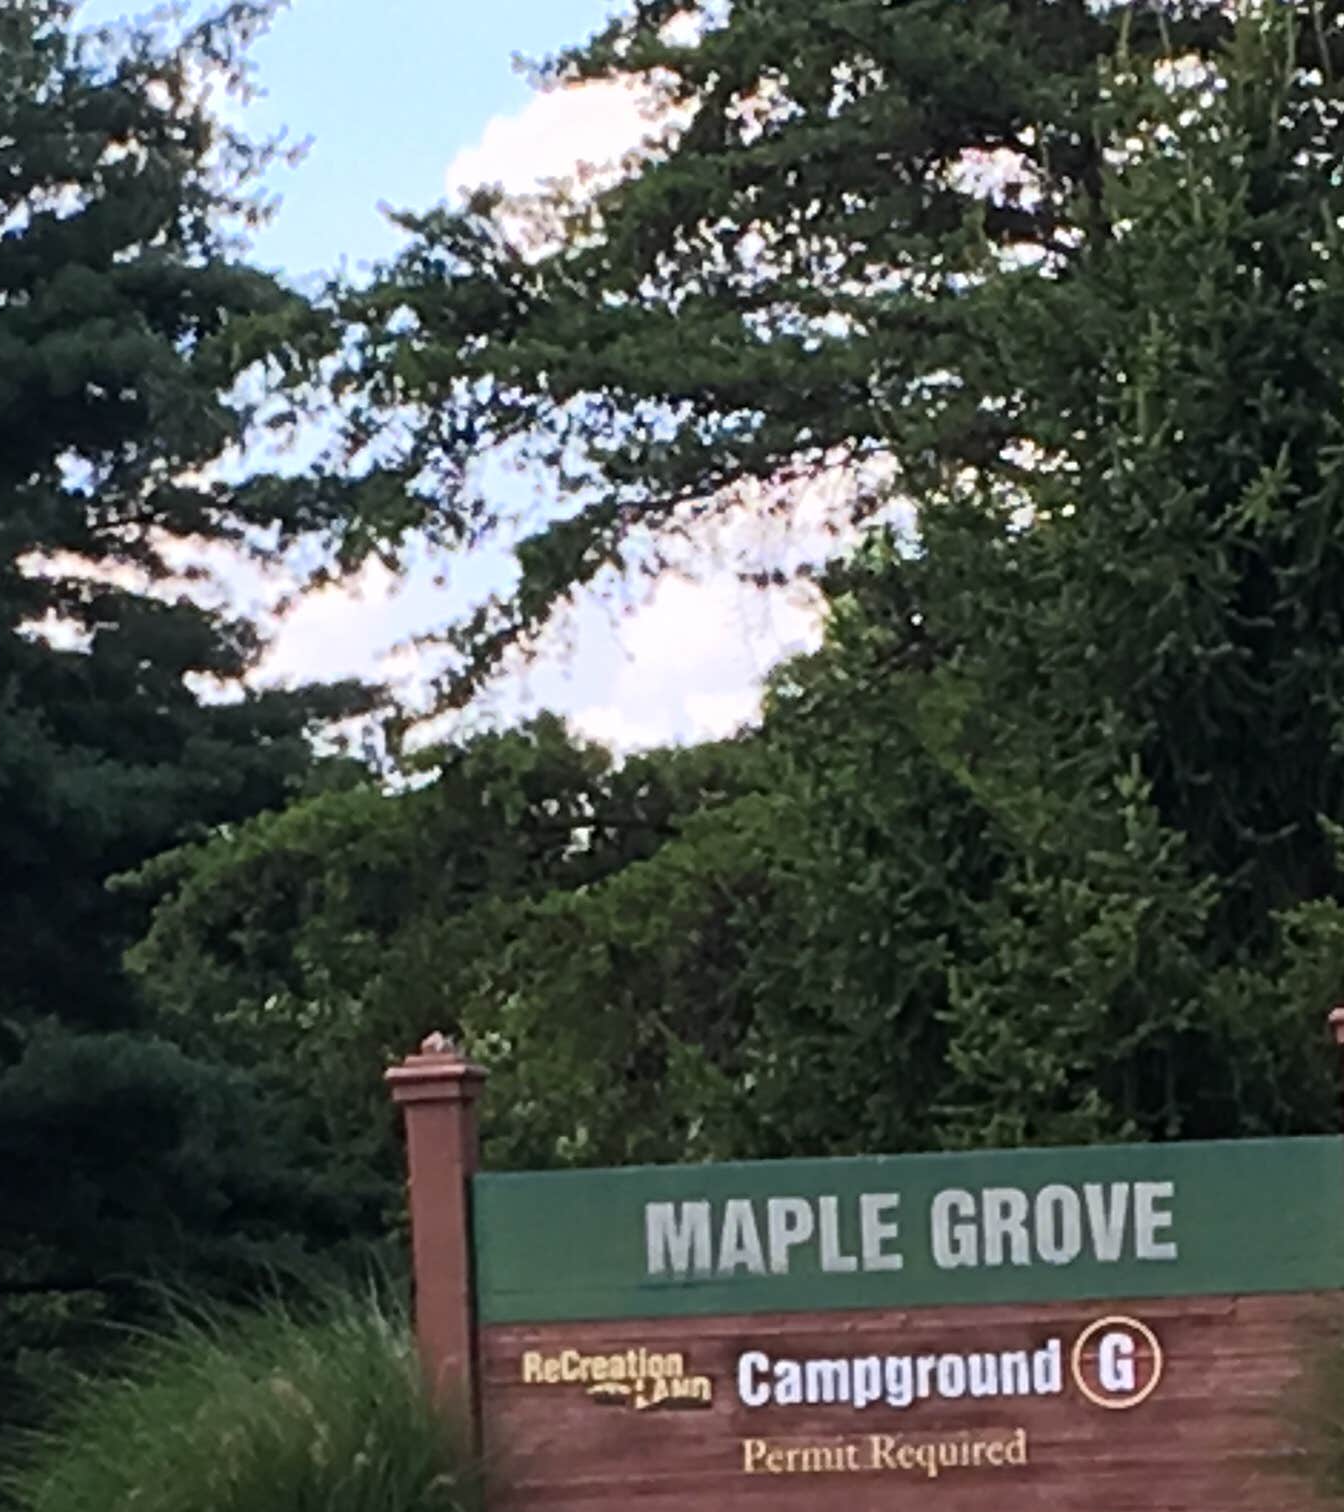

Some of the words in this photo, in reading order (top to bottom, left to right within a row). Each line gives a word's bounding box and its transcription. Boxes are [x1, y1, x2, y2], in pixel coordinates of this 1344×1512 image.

[645, 1192, 903, 1275] MAPLE
[930, 1180, 1178, 1270] GROVE
[522, 1348, 684, 1383] ReCreation
[737, 1338, 1063, 1408] Campground
[1099, 1332, 1137, 1391] G
[743, 1438, 859, 1474] Permit
[869, 1429, 1028, 1477] Required
